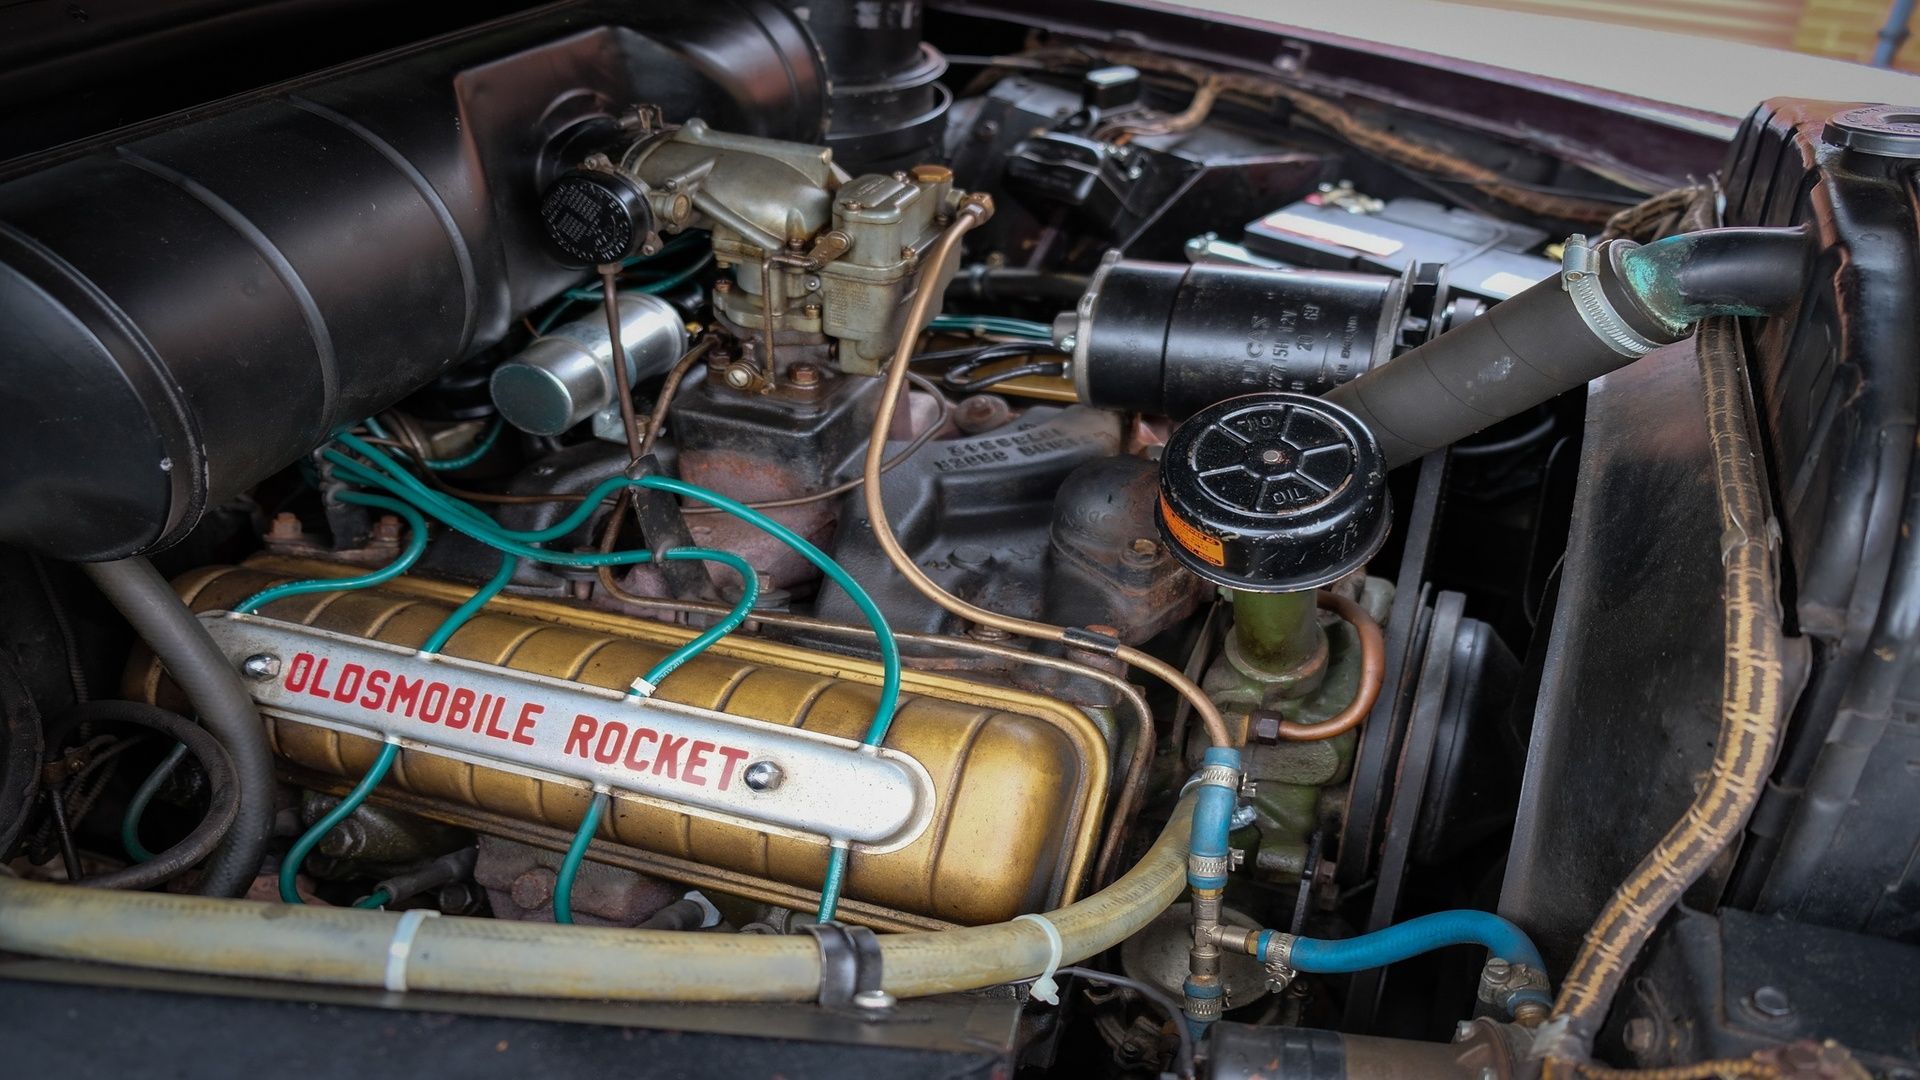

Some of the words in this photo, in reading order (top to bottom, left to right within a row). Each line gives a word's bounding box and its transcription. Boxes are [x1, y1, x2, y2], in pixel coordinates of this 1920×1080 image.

[1272, 487, 1309, 505] OIL
[284, 653, 546, 746] OLDSMOBILE
[564, 714, 749, 792] ROCKET
